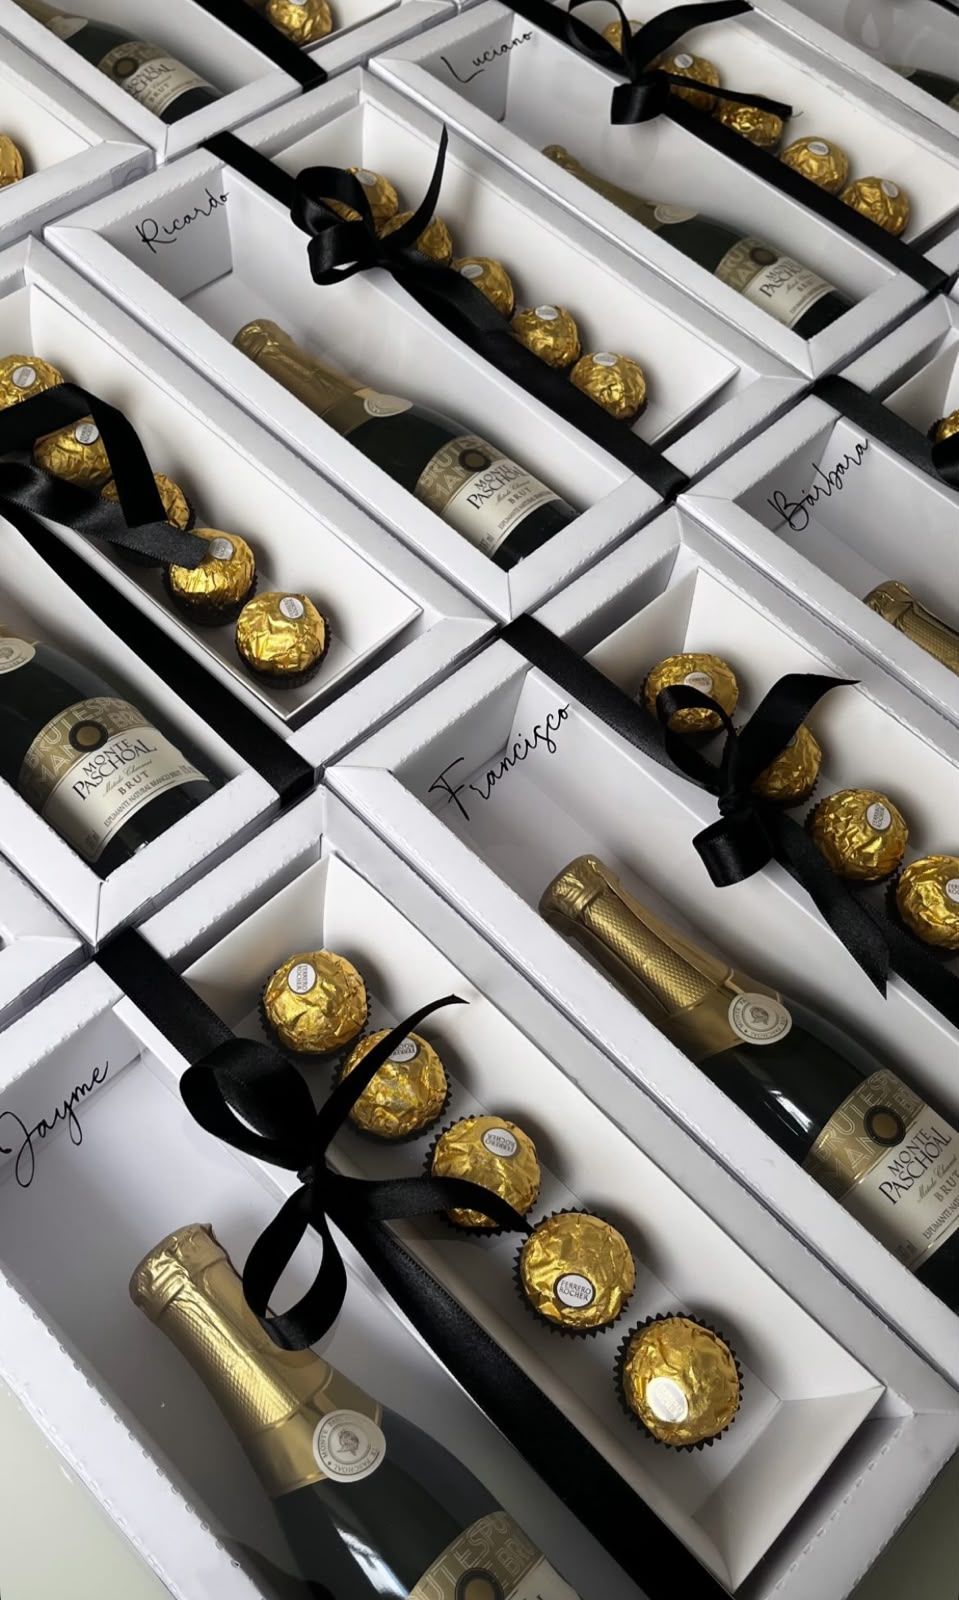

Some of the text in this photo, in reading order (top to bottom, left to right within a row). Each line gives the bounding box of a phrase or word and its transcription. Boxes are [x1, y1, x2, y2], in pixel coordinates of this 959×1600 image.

[440, 31, 533, 84] Luciano
[135, 188, 230, 254] Ricardo
[507, 486, 532, 505] BRUT
[71, 738, 158, 801] PASCHOAL
[82, 738, 133, 778] MONTE
[427, 703, 570, 822] Francisco
[117, 769, 150, 797] BRUT
[878, 1127, 953, 1205] PASCHOAL
[887, 1128, 932, 1176] MONTE
[558, 1287, 589, 1301] ROCHER
[561, 1280, 591, 1295] FERRERO
